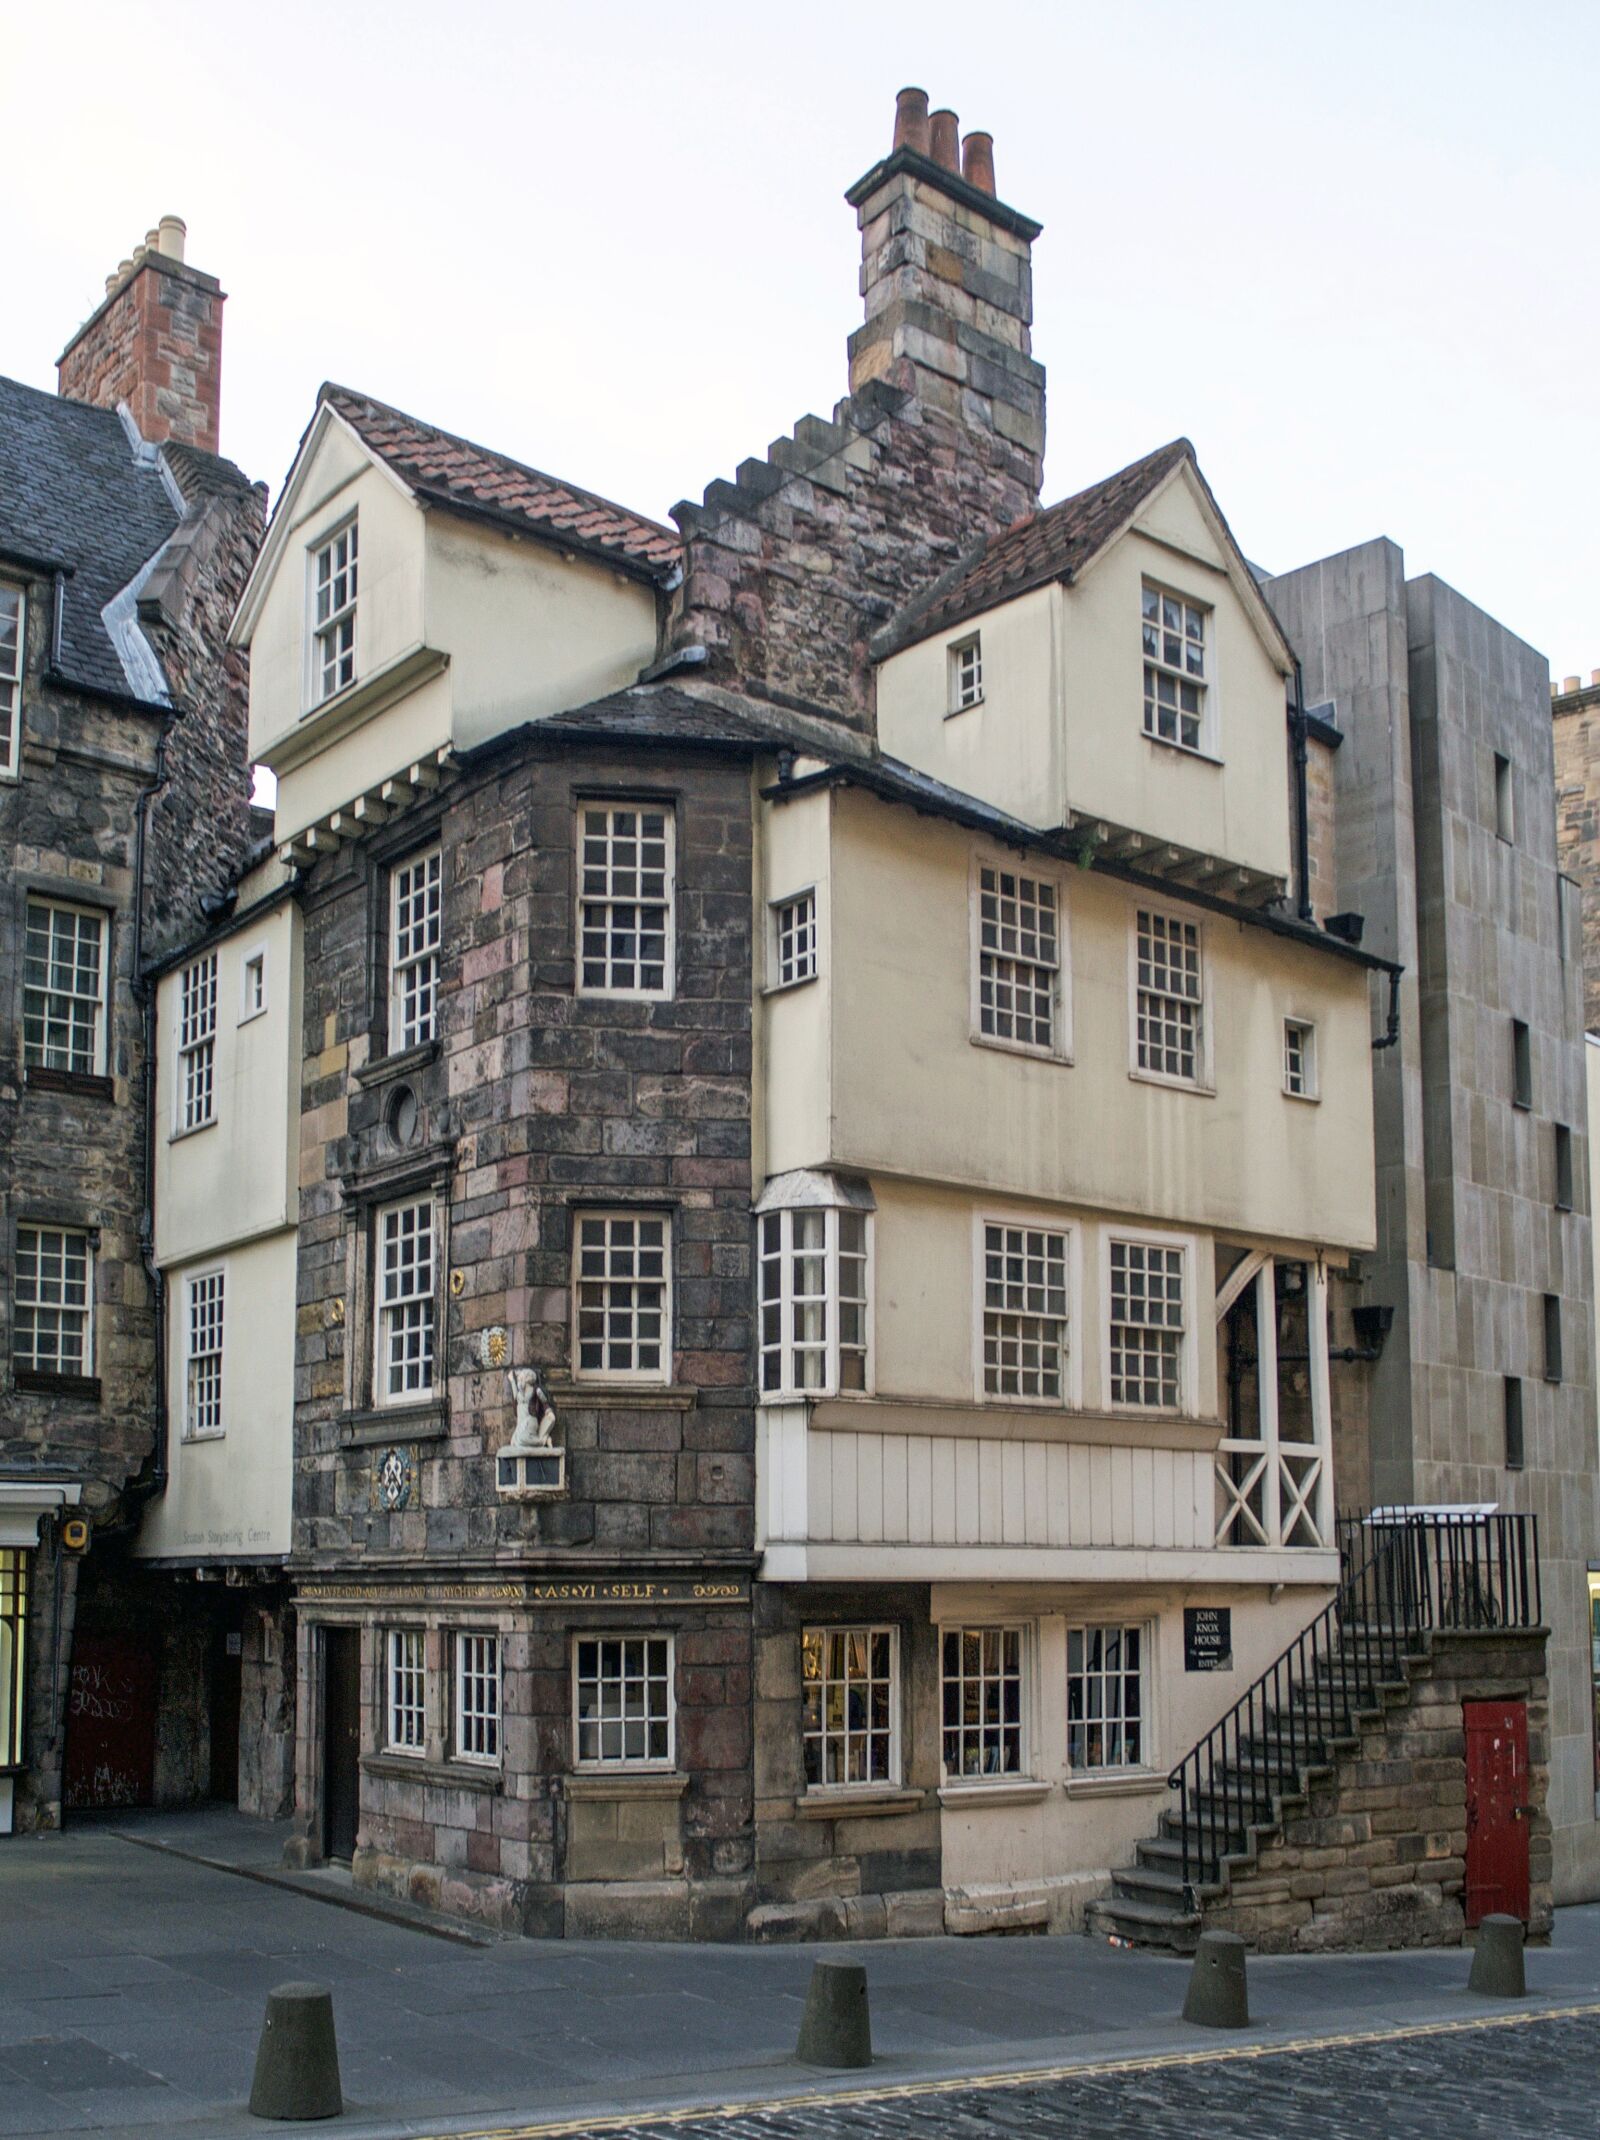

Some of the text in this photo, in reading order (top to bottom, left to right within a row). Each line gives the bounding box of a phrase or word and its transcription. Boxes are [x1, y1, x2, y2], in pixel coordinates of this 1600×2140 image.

[247, 1528, 271, 1543] Centre
[545, 1584, 569, 1598] AS
[610, 1584, 656, 1597] SELF
[1197, 1611, 1217, 1621] JOHN
[1196, 1623, 1219, 1633] KNOX
[1194, 1635, 1221, 1645] HOUSE
